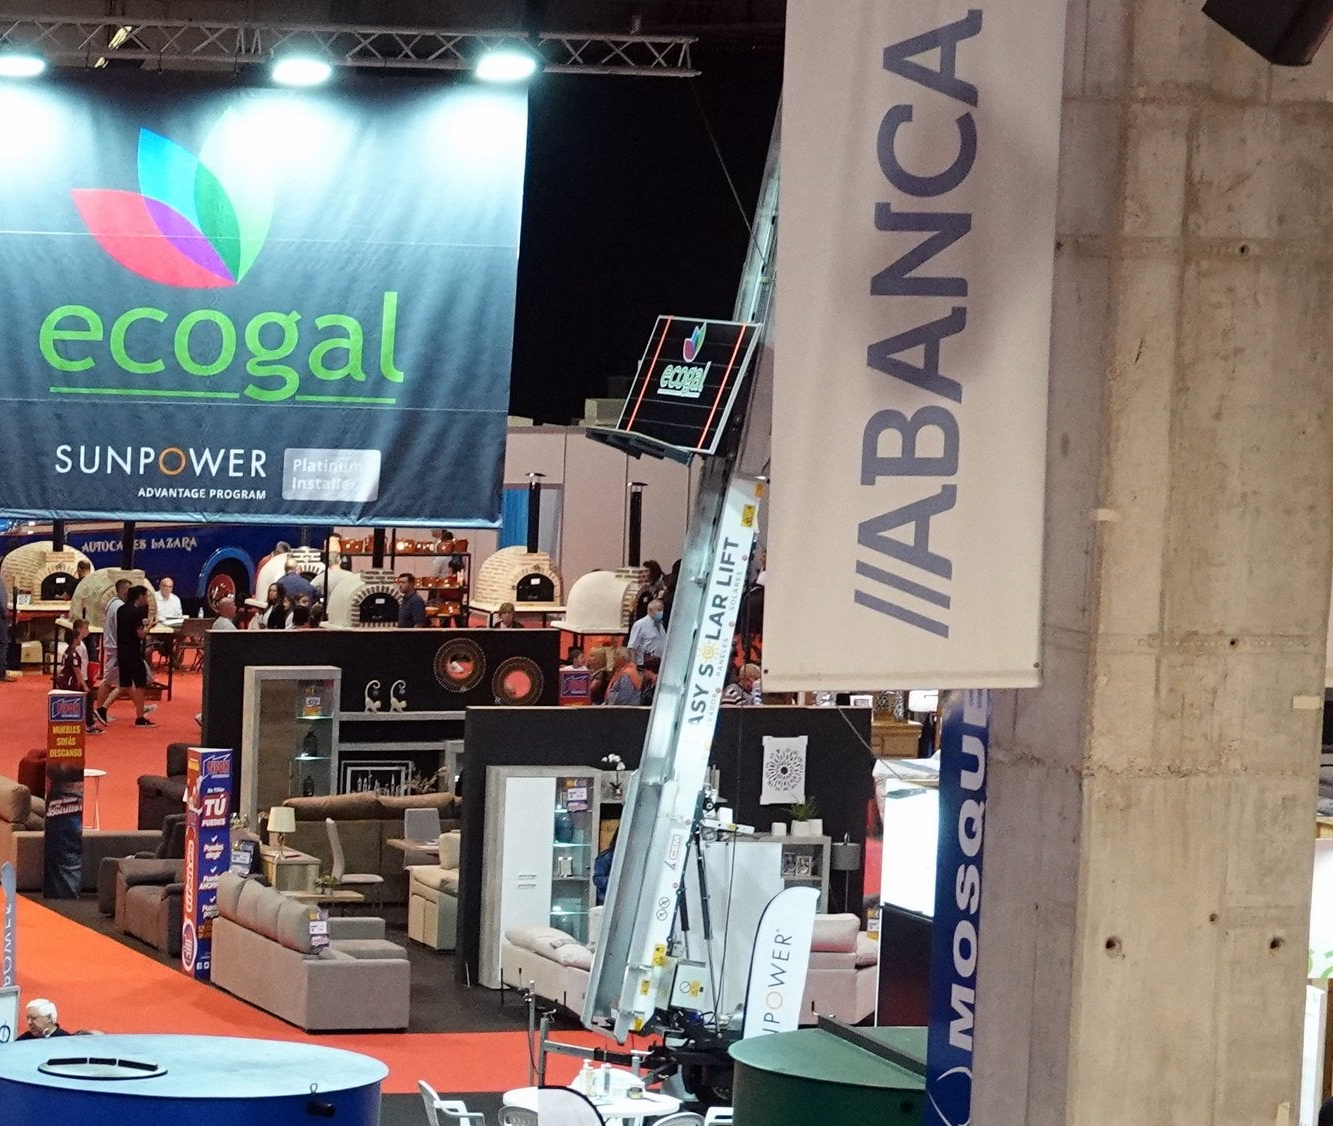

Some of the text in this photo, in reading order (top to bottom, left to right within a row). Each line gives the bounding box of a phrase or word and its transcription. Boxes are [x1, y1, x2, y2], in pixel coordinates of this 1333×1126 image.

[39, 291, 404, 401] ecogal
[659, 361, 712, 396] ecogal
[55, 445, 267, 479] SUNPOWER
[138, 487, 267, 501] ADVANTAGE PROGRAM
[81, 537, 147, 553] AUTOCAES
[715, 536, 740, 587] LIFT
[204, 794, 227, 817] TÚ
